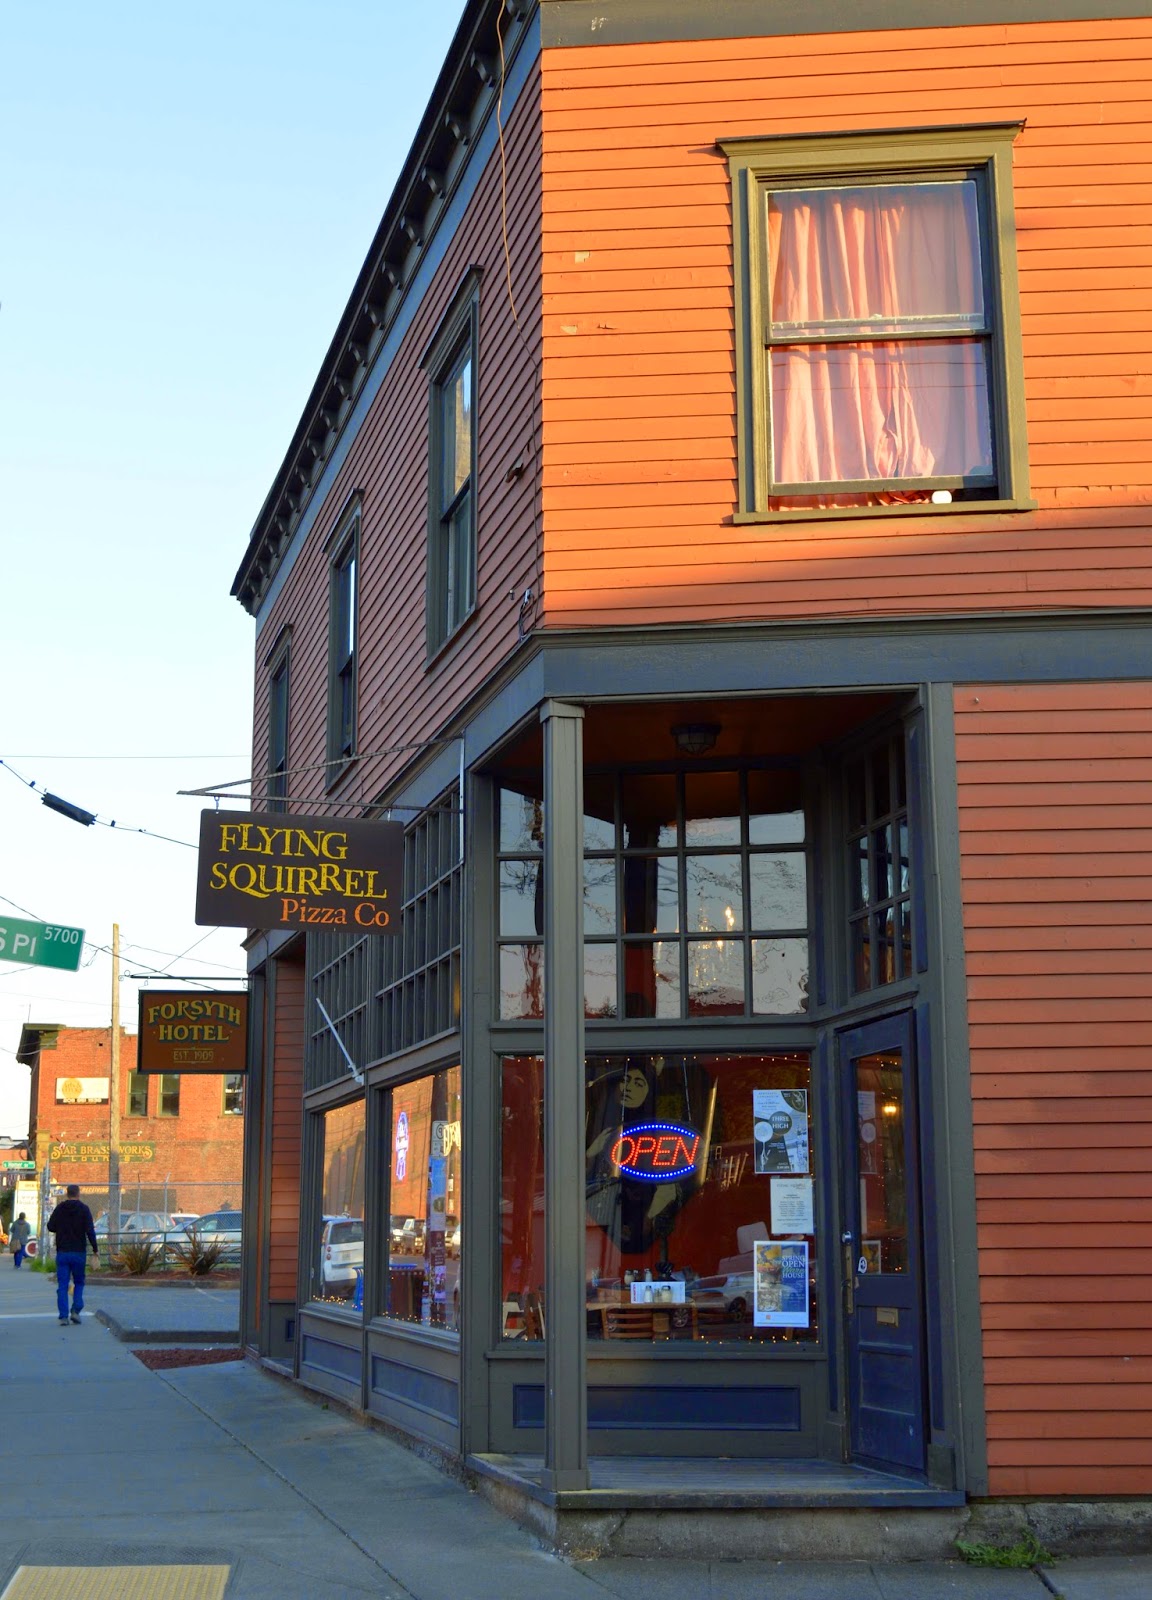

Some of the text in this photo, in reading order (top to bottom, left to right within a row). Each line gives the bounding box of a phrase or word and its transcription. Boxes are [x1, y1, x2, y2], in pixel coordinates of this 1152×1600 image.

[218, 823, 348, 860] FLYING
[209, 862, 387, 899] SQUIRREL
[280, 898, 390, 927] Pizza Co
[12, 933, 37, 957] Pl
[44, 926, 79, 945] 5700
[148, 1000, 240, 1025] FORSYTH
[159, 1025, 229, 1041] HOTEL
[194, 1051, 214, 1060] 1909
[611, 1136, 700, 1166] OPEN
[781, 1260, 805, 1268] OPEN
